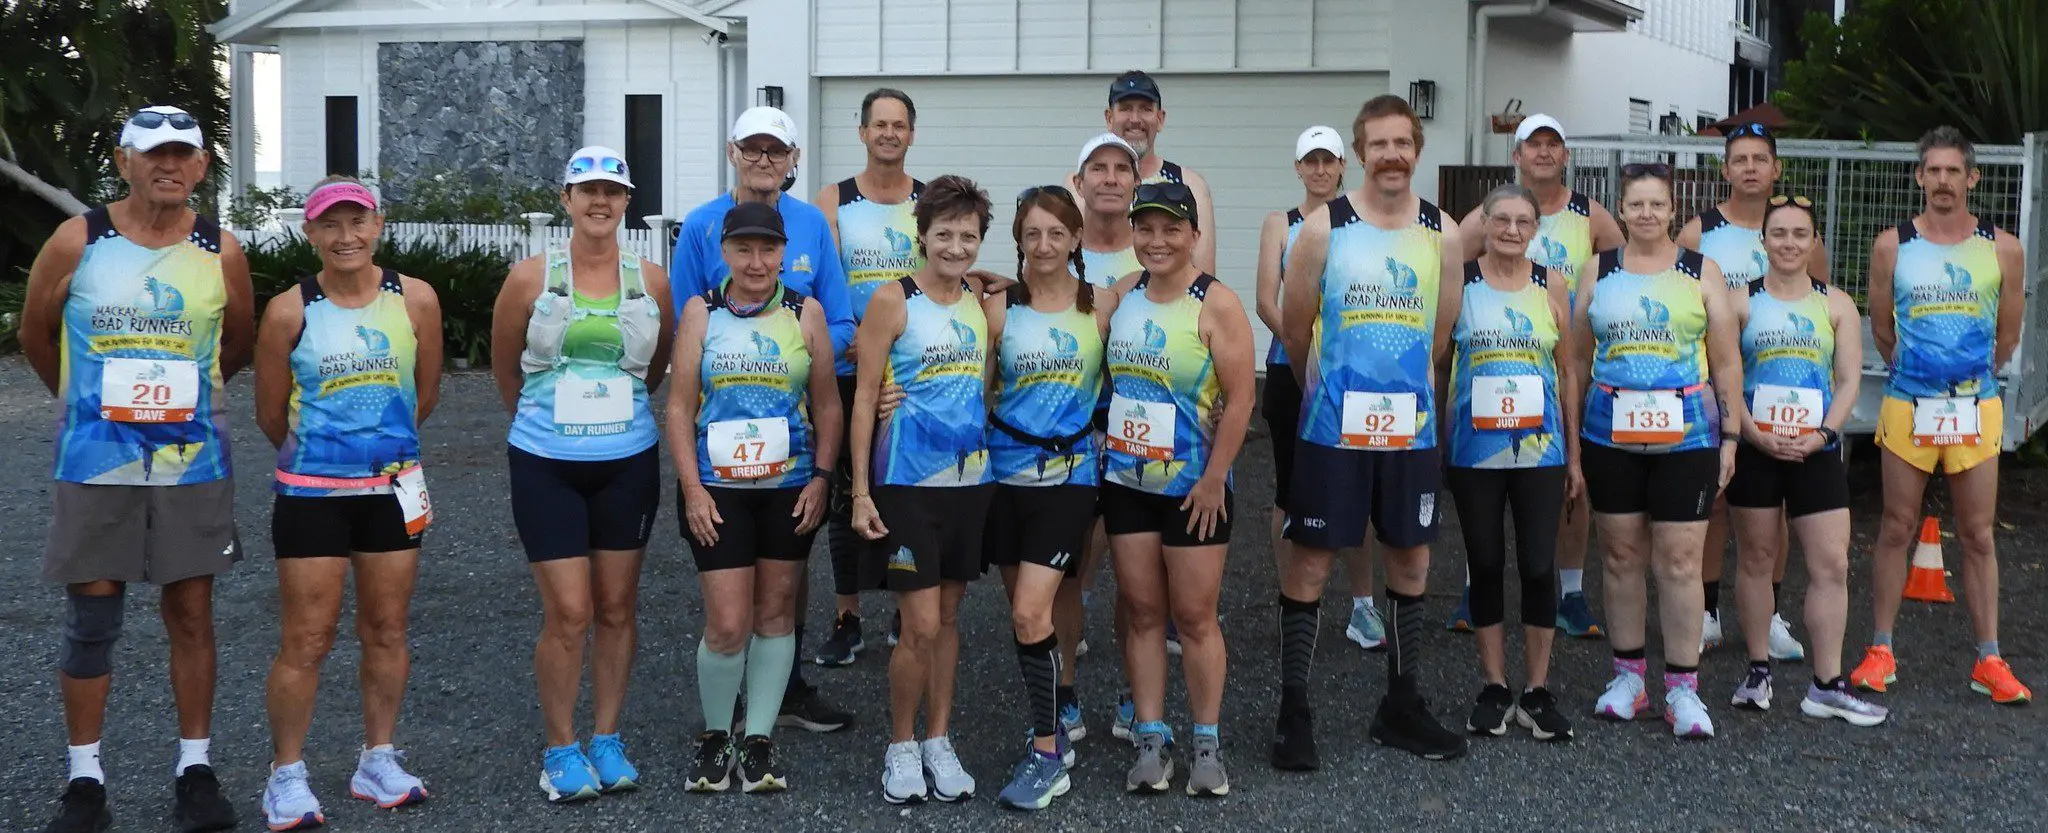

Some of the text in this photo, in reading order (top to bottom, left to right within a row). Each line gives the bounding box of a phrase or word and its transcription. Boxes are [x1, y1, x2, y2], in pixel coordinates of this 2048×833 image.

[850, 257, 917, 269] ROAD RUNNERS
[1349, 283, 1382, 293] MACKAY
[1344, 294, 1424, 311] ROAD RUNNERS
[1910, 290, 1979, 303] ROAD RUNNERS
[97, 306, 139, 317] MACKAY
[92, 316, 193, 336] ROAD RUNNERS
[1607, 329, 1676, 342] ROAD RUNNERS
[1755, 336, 1821, 348] ROAD RUNNERS
[1469, 338, 1541, 350] ROAD RUNNERS
[716, 352, 747, 360] MACKAY
[921, 349, 983, 366] ROAD RUNNERS
[1125, 349, 1171, 371] RUNNERS
[318, 356, 400, 377] ROAD RUNNERS
[711, 360, 789, 375] ROAD RUNNERS
[1013, 358, 1084, 373] ROAD RUNNERS
[132, 384, 171, 405] 20
[1501, 396, 1515, 414] 8
[134, 409, 166, 421] DAVE
[1626, 411, 1670, 428] 133
[1767, 404, 1810, 425] 102
[564, 422, 626, 436] DAY RUNNER
[1365, 414, 1396, 432] 92
[1496, 417, 1520, 429] JUDY
[1933, 416, 1958, 431] 71
[1123, 420, 1151, 442] 82
[1368, 435, 1388, 446] ASH
[1932, 434, 1963, 445] JUSTIN
[733, 442, 766, 461] 47
[1125, 441, 1148, 457] TASH
[731, 464, 771, 478] BRENDA
